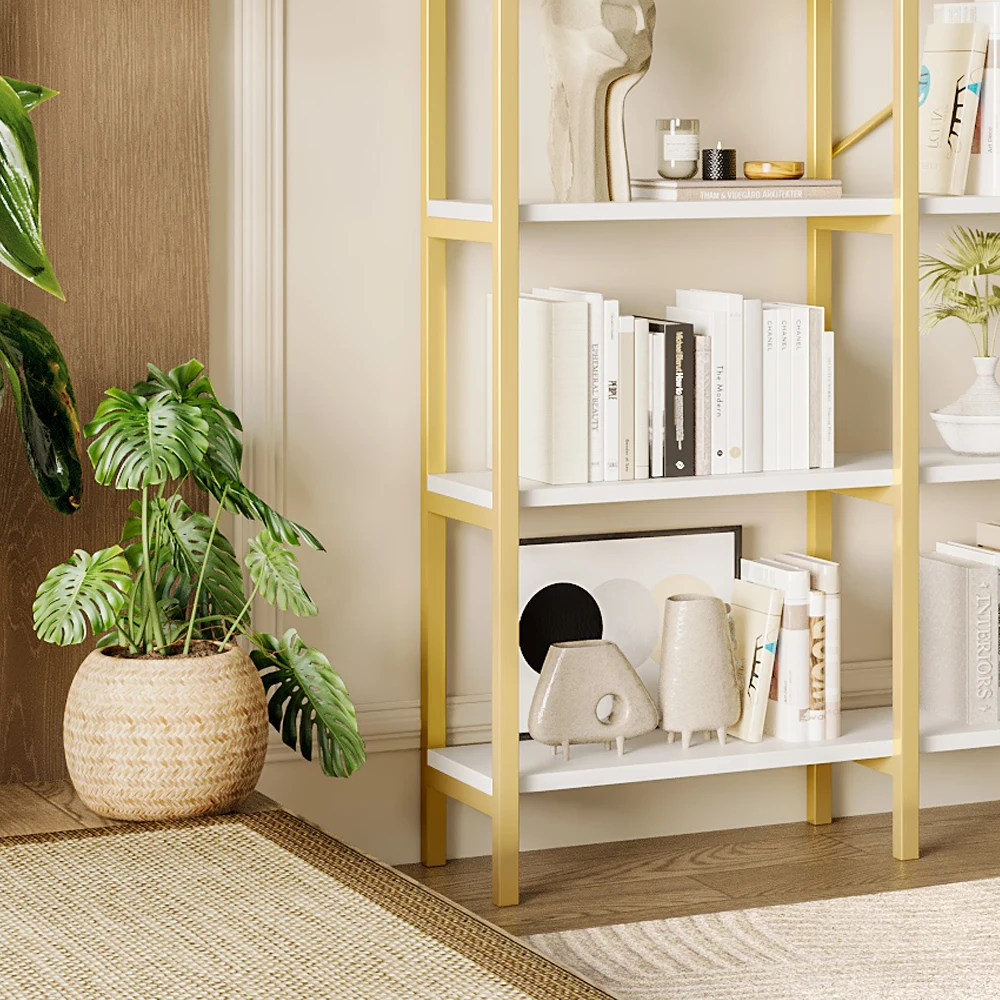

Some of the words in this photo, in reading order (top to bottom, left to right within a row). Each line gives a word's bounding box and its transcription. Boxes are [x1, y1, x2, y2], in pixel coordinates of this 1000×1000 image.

[700, 191, 719, 199] THAM
[716, 365, 724, 380] The
[716, 384, 724, 418] Modern
[976, 593, 994, 699] INTERIORS
